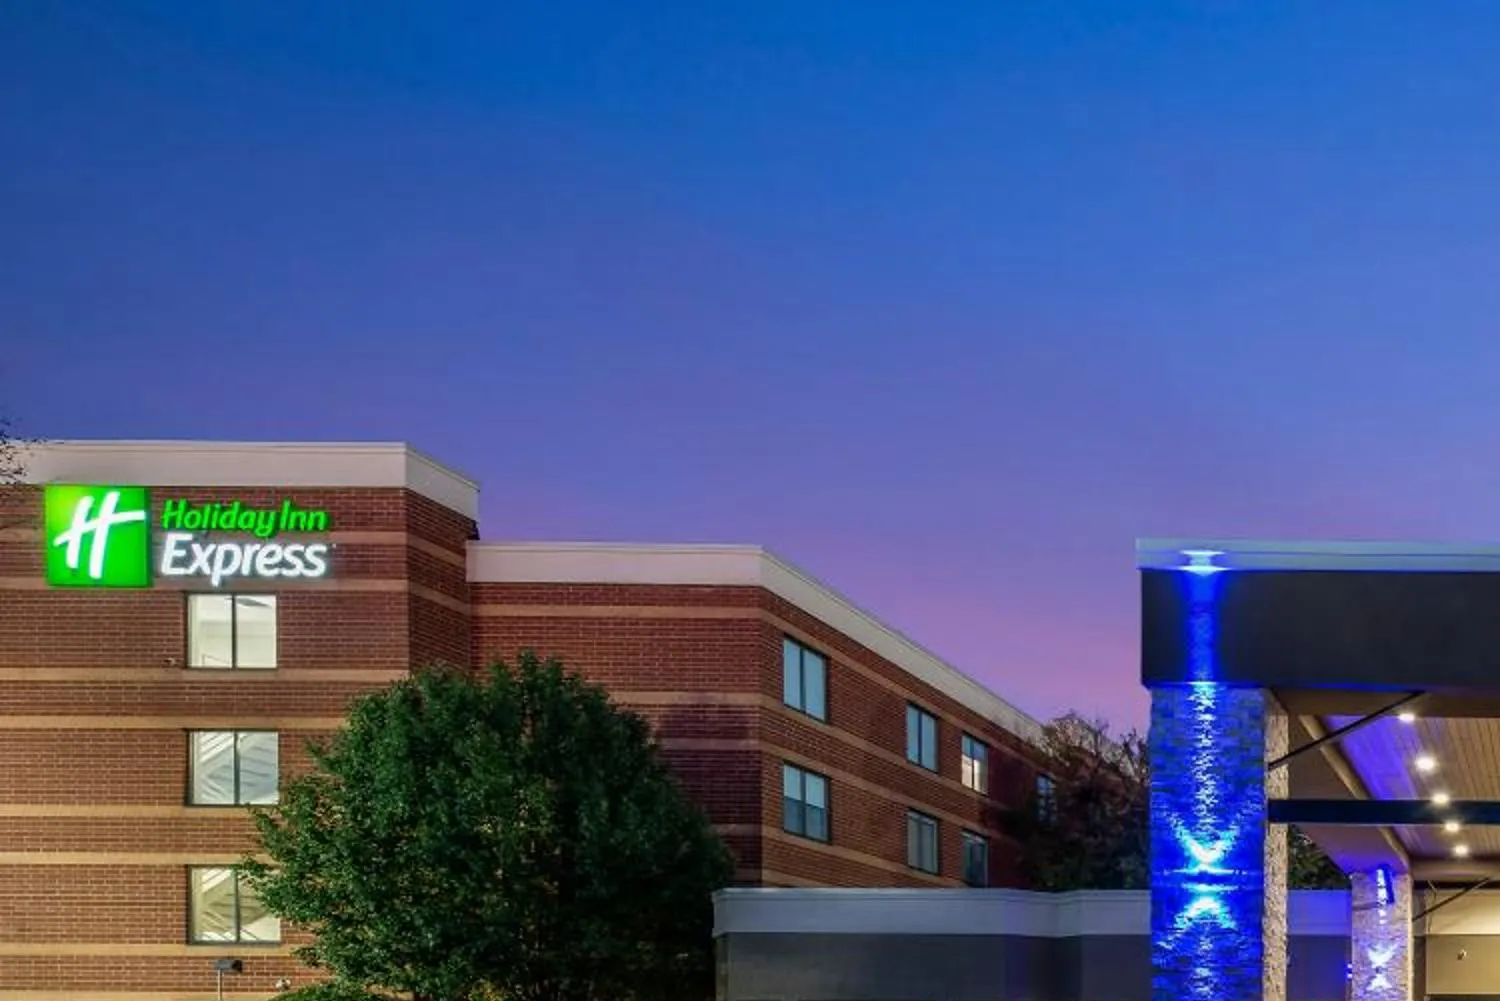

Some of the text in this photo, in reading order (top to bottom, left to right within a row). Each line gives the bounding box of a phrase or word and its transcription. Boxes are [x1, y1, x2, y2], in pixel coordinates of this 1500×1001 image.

[161, 500, 328, 536] Holiday Inn
[161, 532, 328, 587] Express
